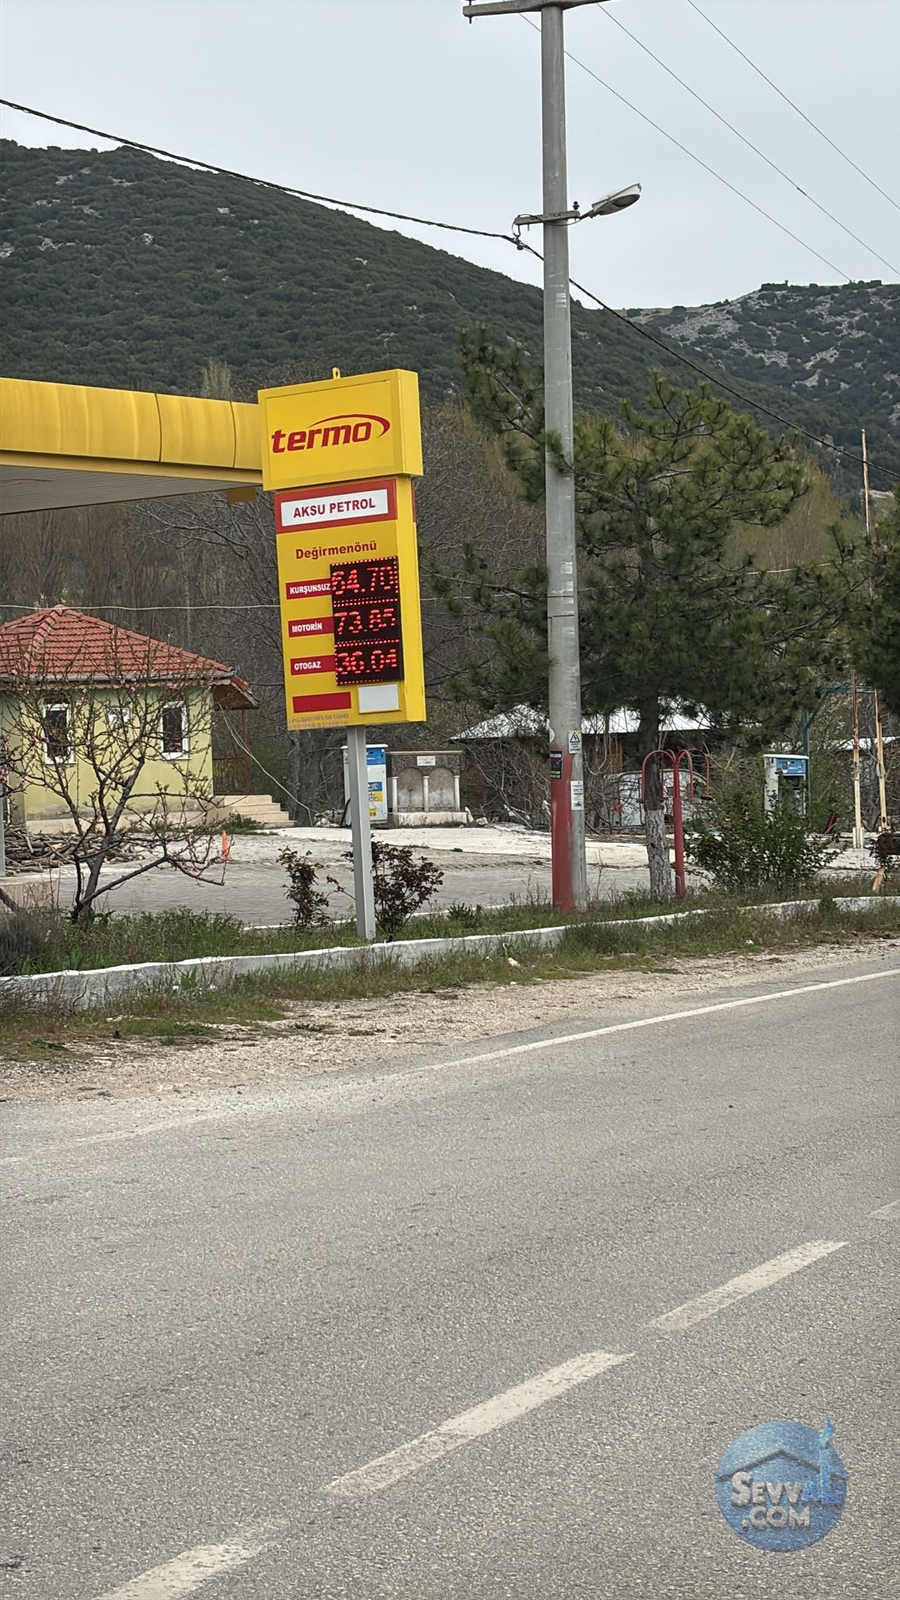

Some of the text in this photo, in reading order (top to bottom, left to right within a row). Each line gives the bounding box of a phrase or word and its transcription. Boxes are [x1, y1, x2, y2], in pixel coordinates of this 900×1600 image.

[271, 421, 373, 454] termo
[293, 497, 376, 519] AKSU PETROL
[295, 540, 377, 560] Değirmenönü
[289, 582, 331, 596] KURŞUNSUZ
[291, 621, 323, 634] MOTORİN
[293, 661, 322, 671] OTOGAZ
